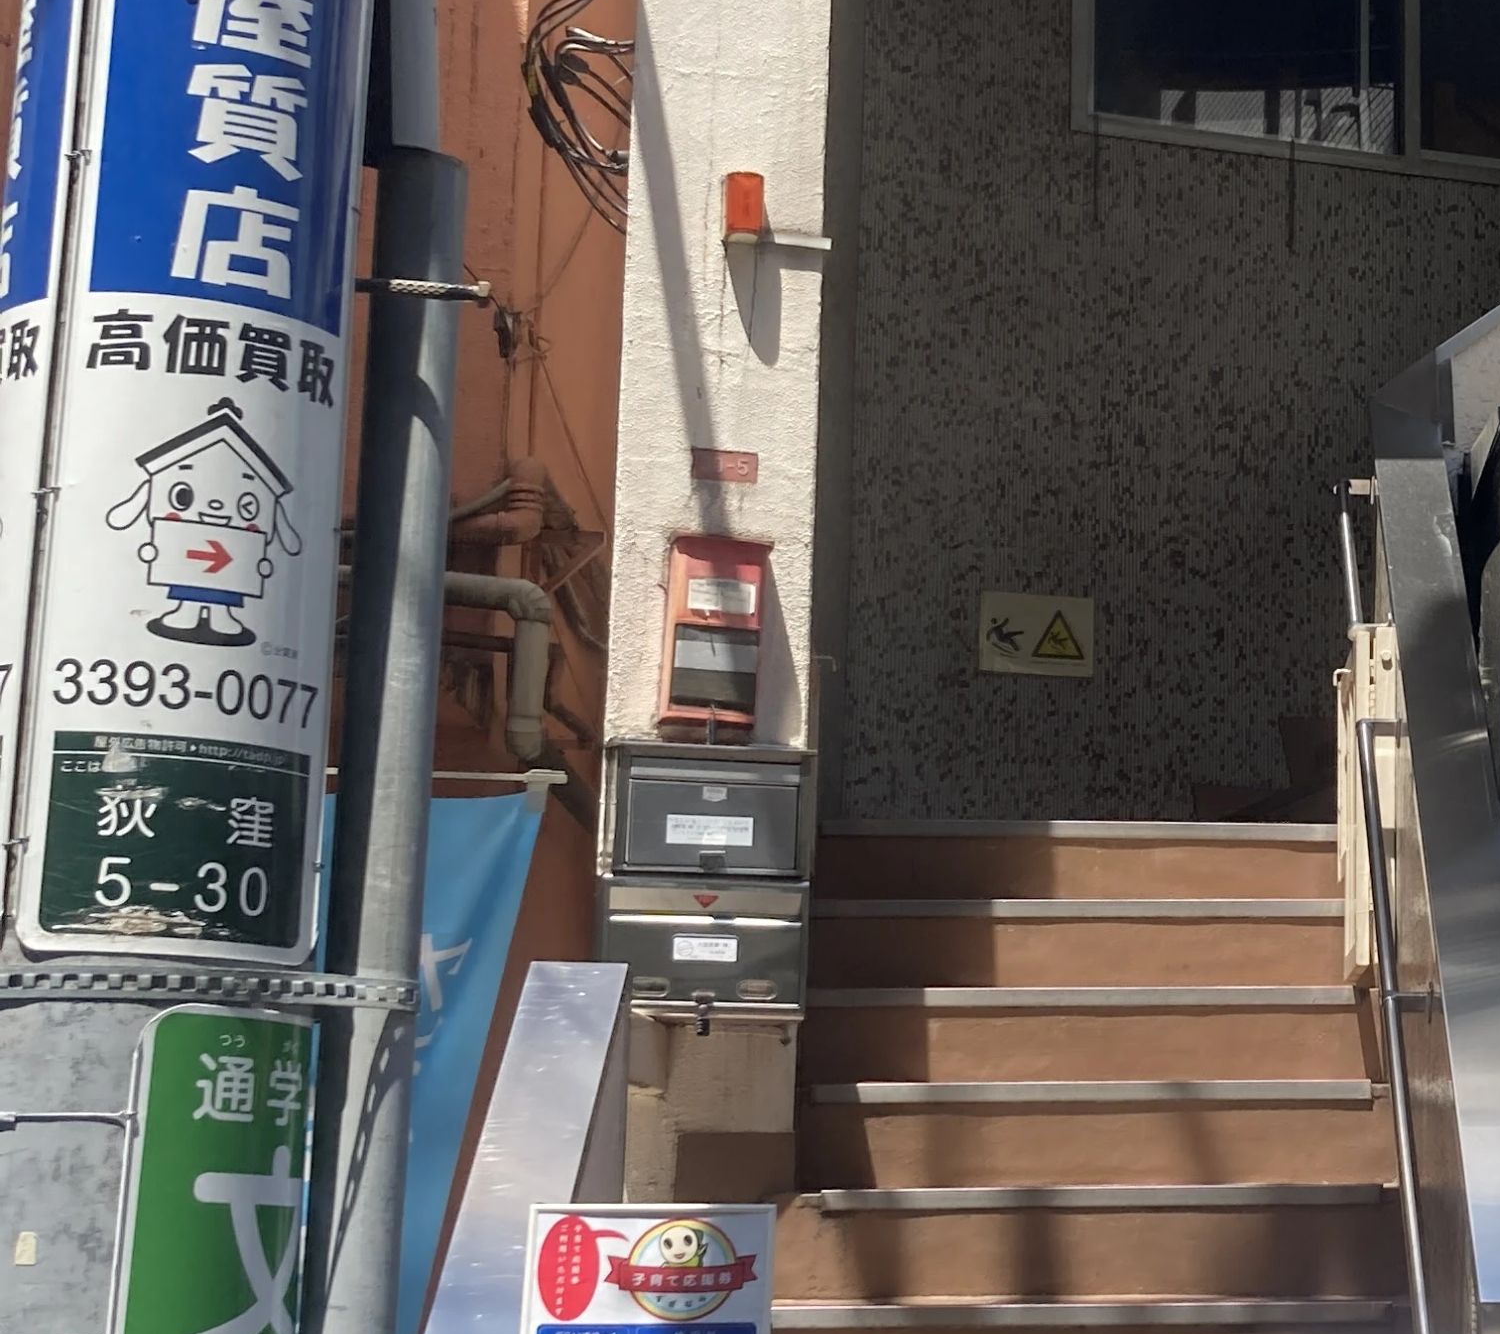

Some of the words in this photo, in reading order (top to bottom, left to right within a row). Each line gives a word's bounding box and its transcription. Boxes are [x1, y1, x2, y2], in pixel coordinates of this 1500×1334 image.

[85, 308, 336, 410] 高価買取
[53, 658, 319, 729] 3393-0077
[94, 856, 268, 917] 5-30
[193, 1052, 303, 1127] 通学
